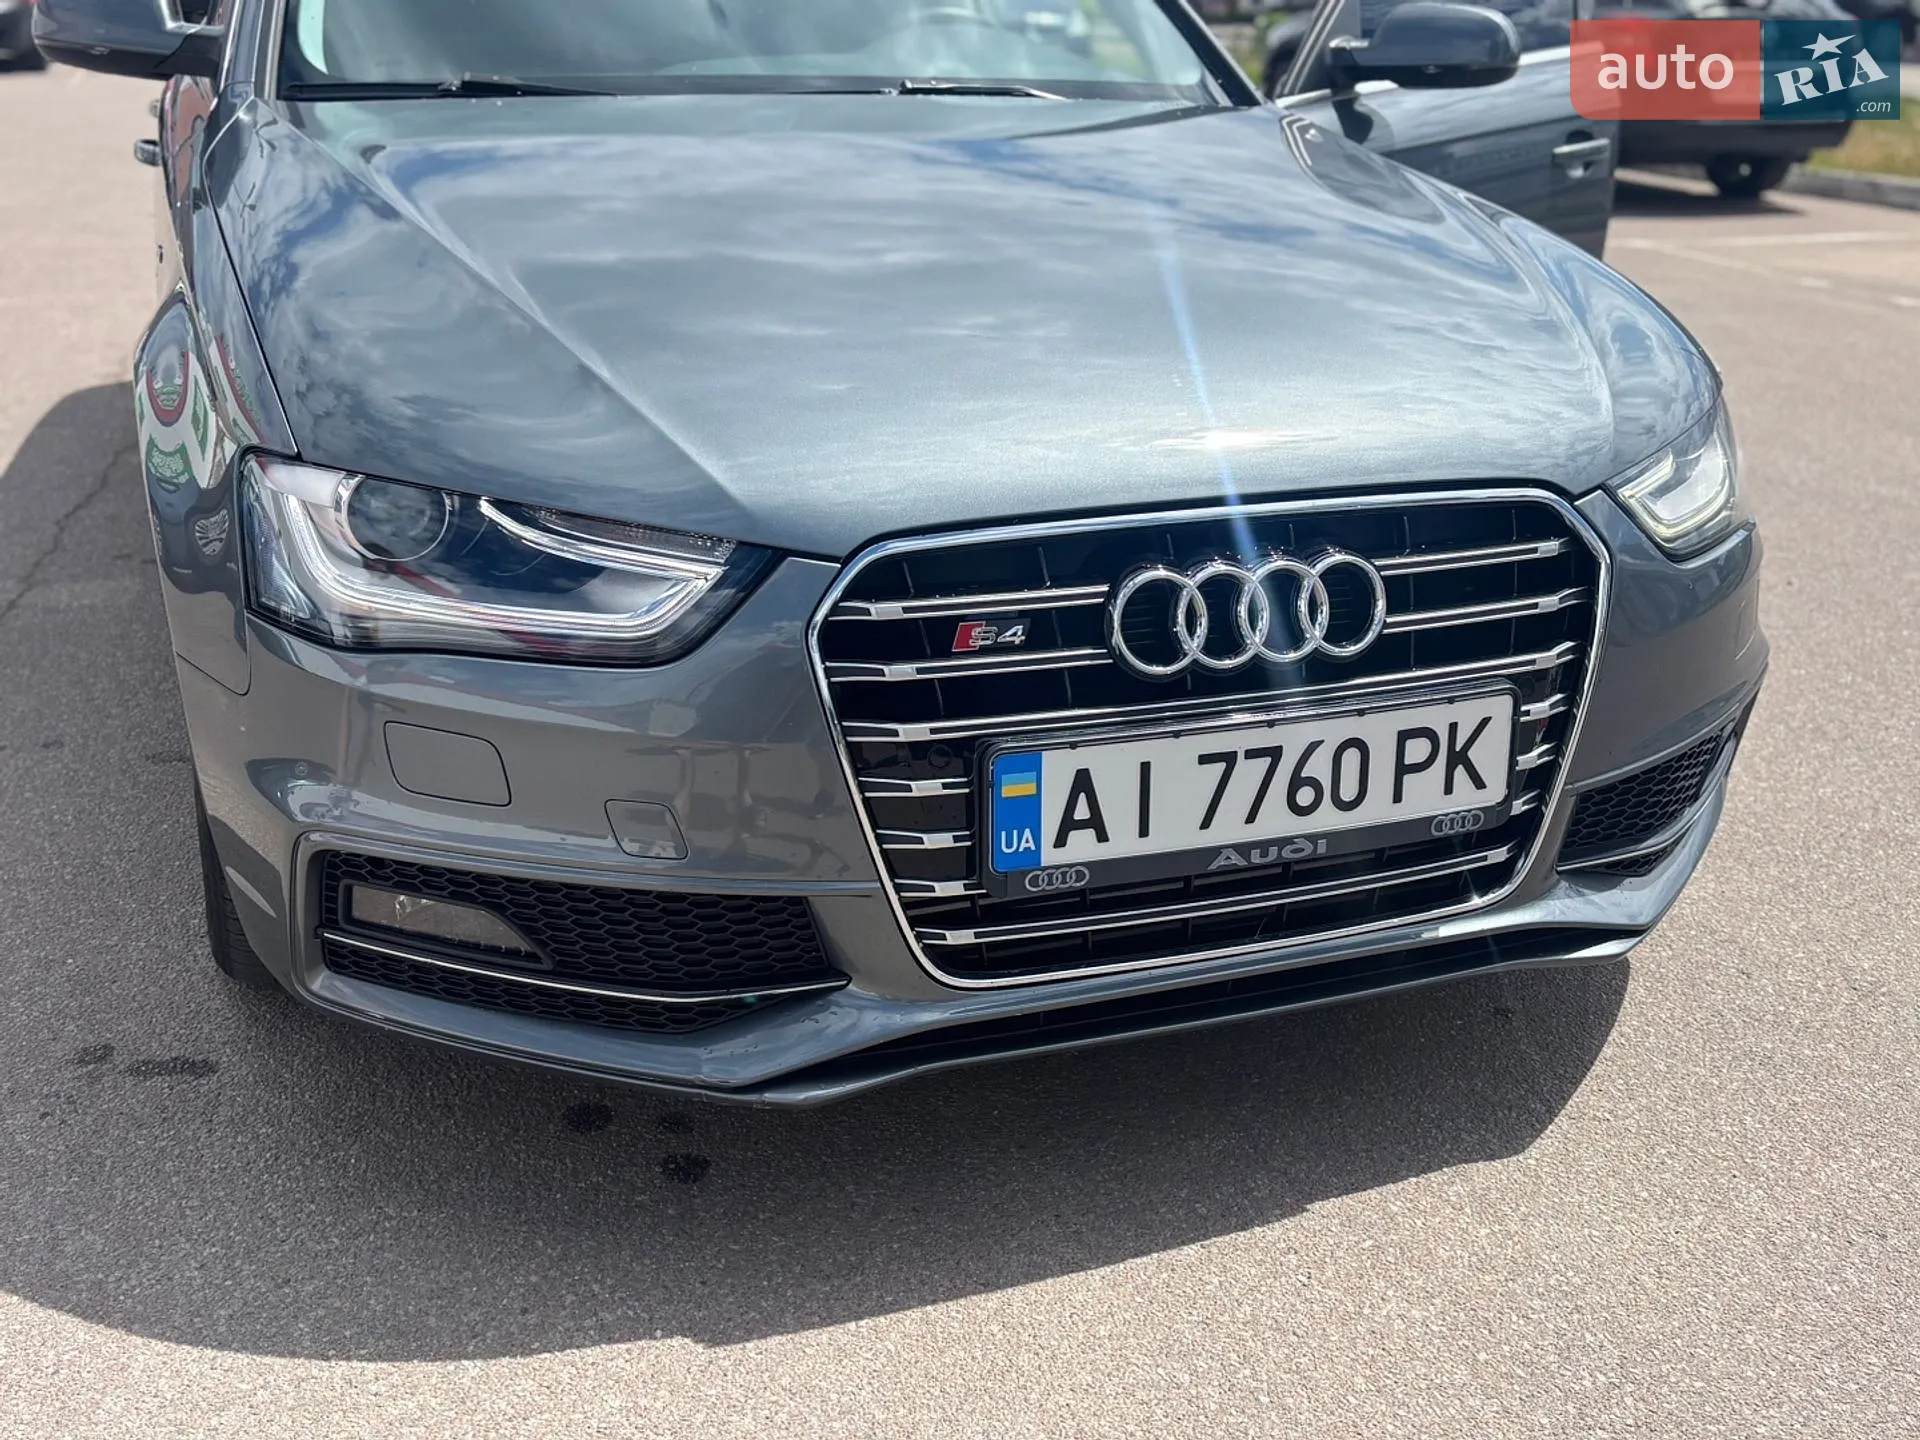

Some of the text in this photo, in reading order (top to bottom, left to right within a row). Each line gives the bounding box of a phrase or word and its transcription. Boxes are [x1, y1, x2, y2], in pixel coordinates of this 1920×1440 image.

[969, 625, 1026, 646] S4
[1052, 716, 1493, 849] AI 7760 PK
[1000, 828, 1037, 855] UA
[1207, 838, 1327, 870] Audi
